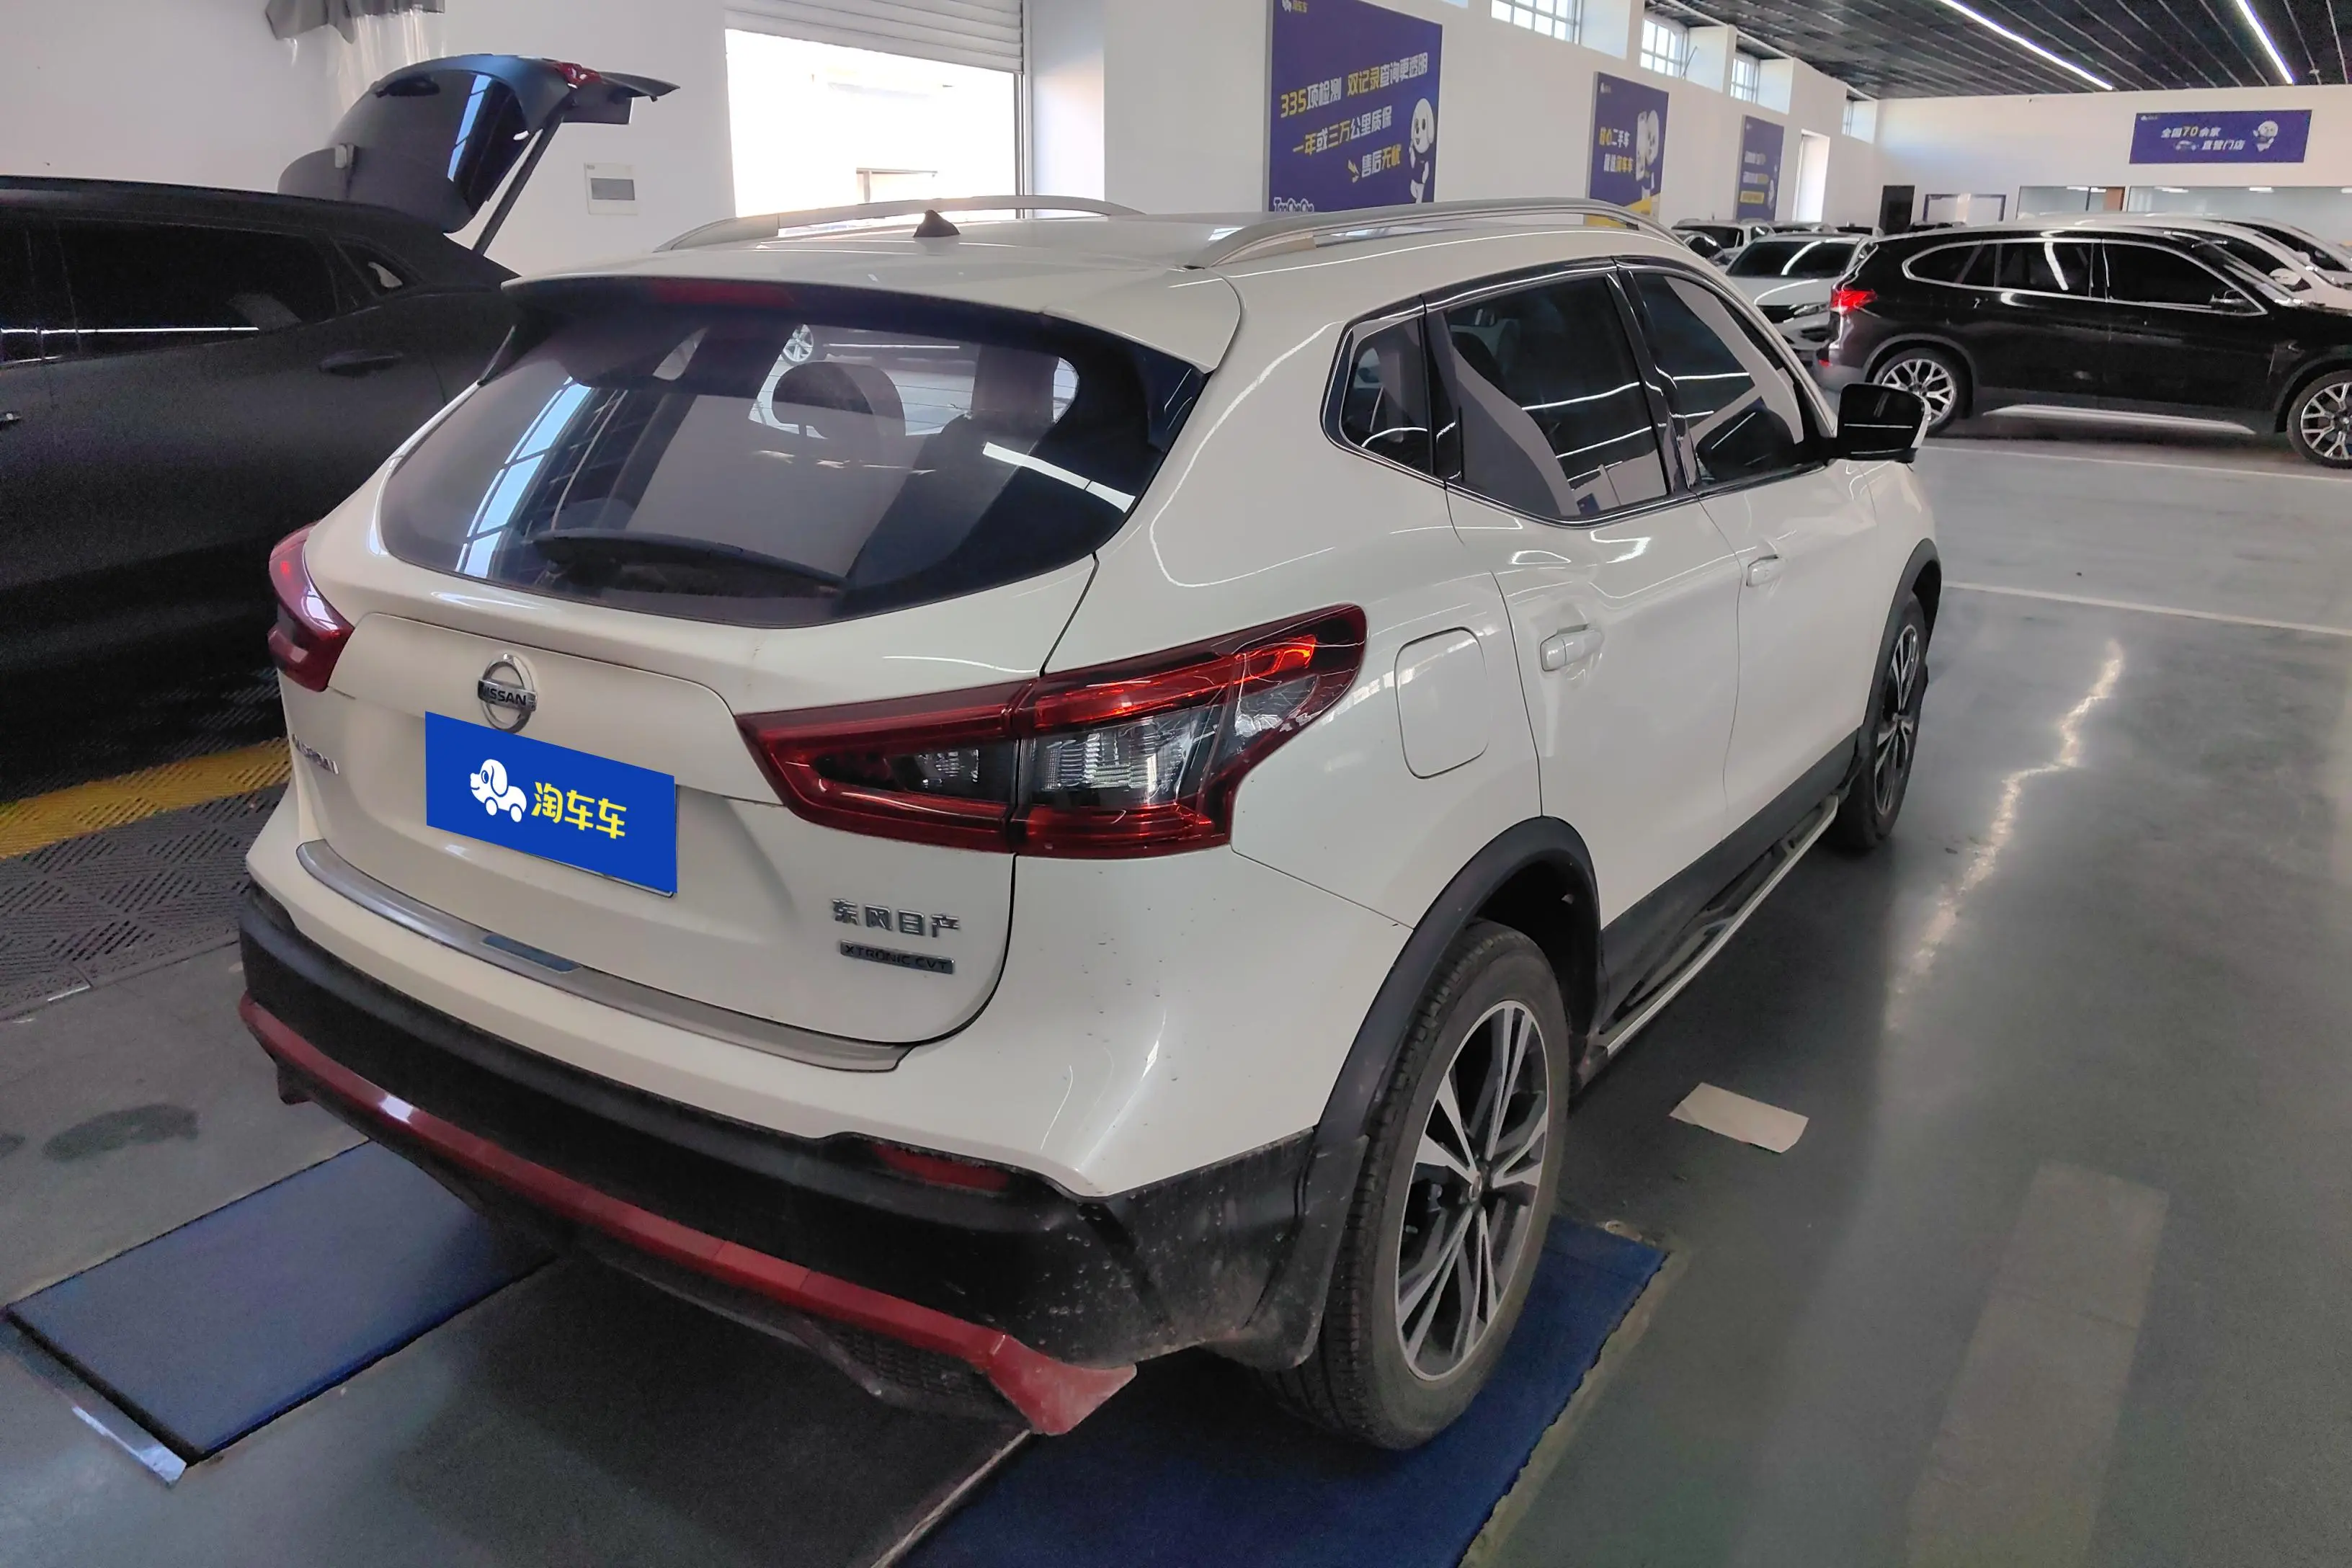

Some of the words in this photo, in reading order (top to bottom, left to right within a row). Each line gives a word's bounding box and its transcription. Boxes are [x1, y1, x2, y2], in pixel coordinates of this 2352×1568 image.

[1280, 76, 1342, 118] 335项检测
[1293, 105, 1392, 156] 一年或三万公里质保
[484, 686, 527, 706] NISSAN
[832, 899, 960, 937] 东风日产
[915, 957, 948, 970] CVT
